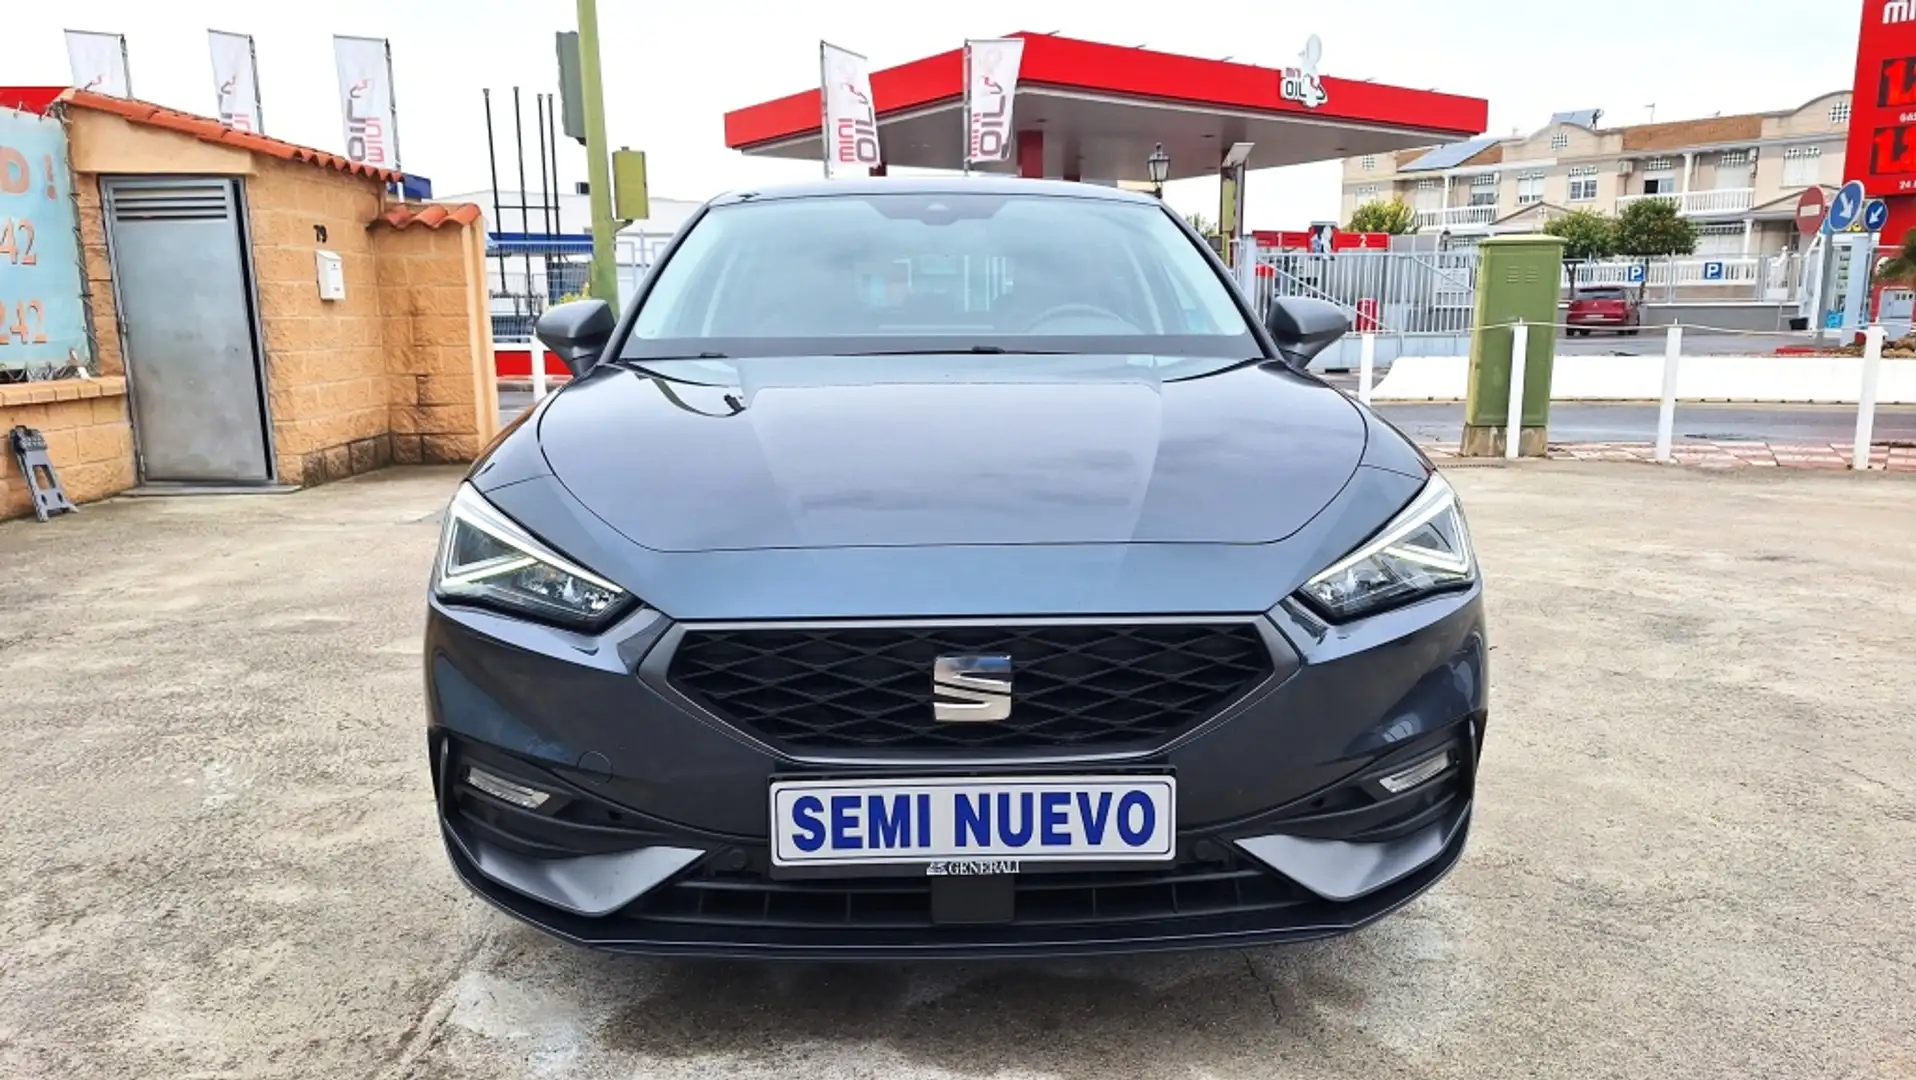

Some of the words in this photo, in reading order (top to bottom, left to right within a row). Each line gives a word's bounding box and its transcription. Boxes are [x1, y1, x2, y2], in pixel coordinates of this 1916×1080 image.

[1285, 80, 1307, 98] OIL
[979, 94, 1006, 156] OIL
[855, 106, 878, 163] OIL
[1630, 267, 1642, 280] P
[1707, 264, 1720, 279] P
[791, 793, 931, 852] SEMI
[954, 789, 1156, 848] NUEVO
[948, 860, 1021, 875] GENERALI
